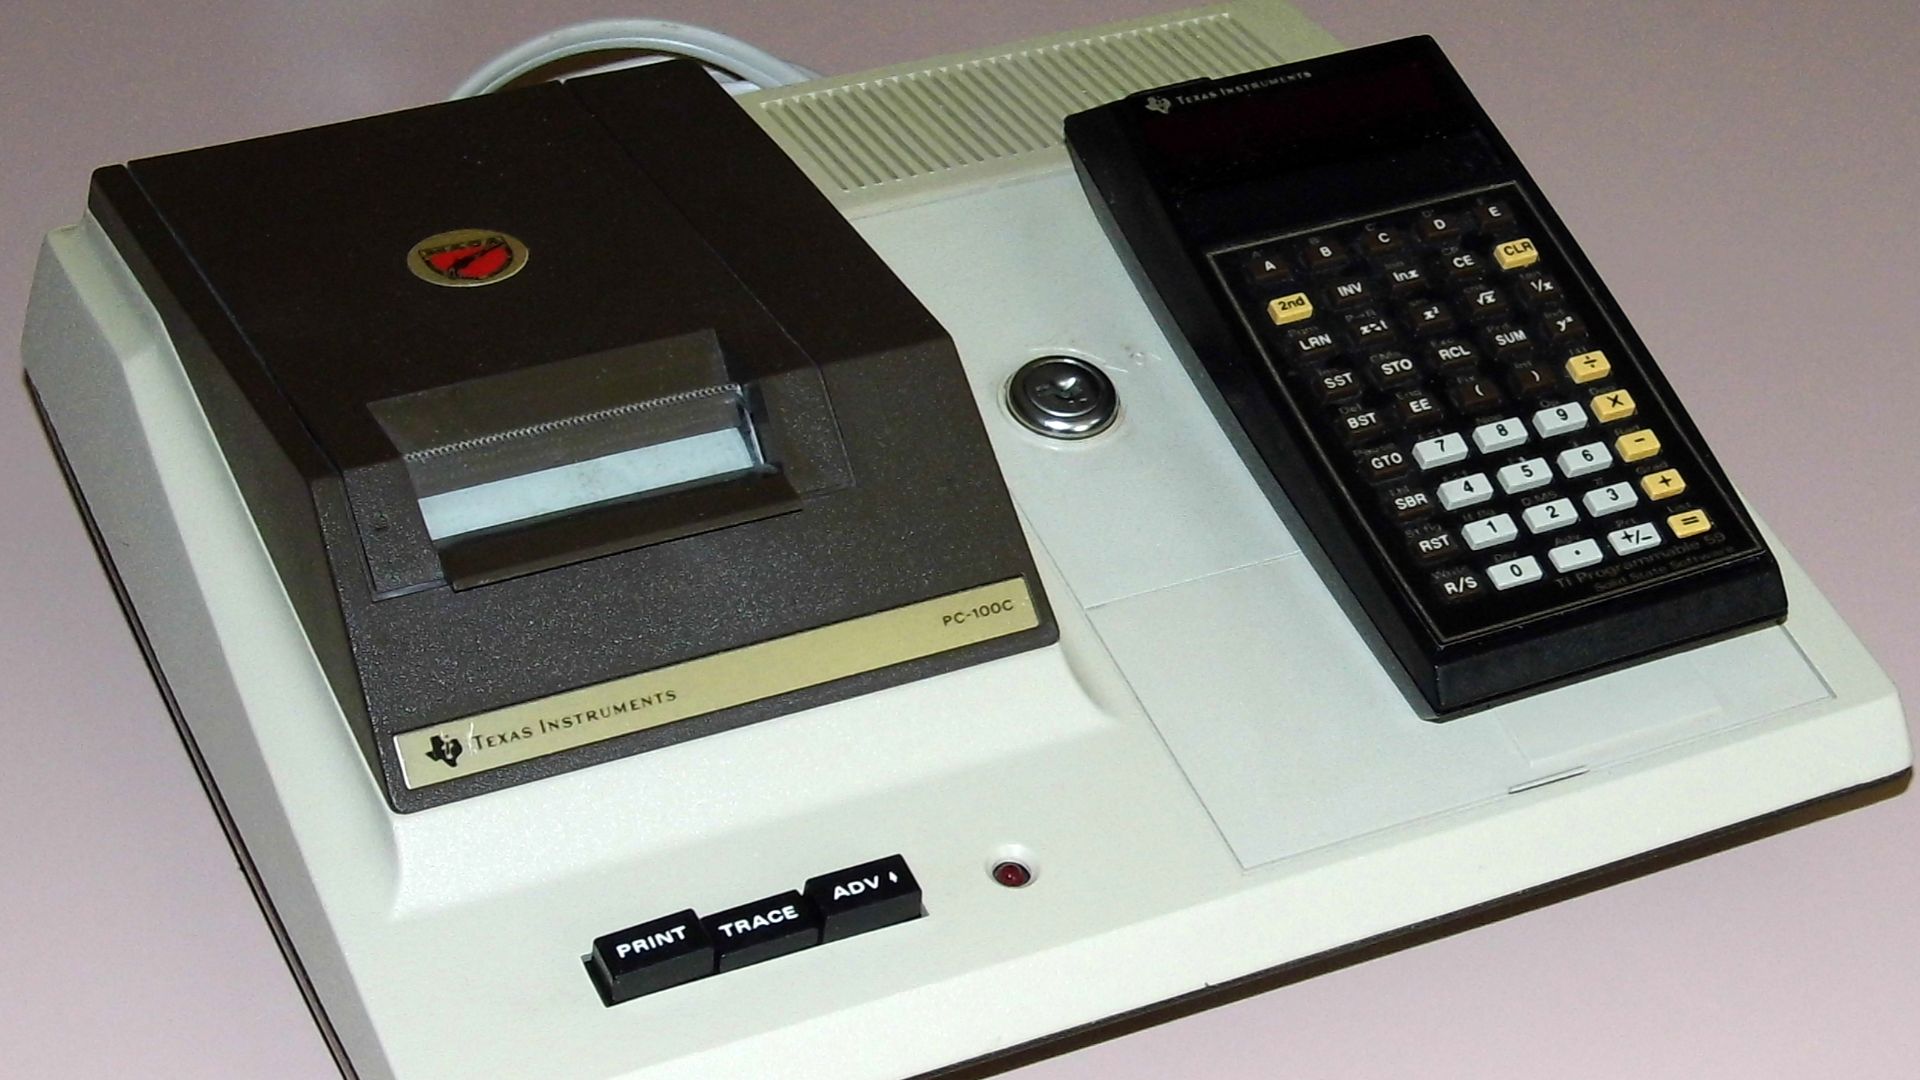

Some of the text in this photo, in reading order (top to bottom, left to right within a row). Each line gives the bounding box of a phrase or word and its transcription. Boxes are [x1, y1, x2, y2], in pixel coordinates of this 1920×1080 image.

[1488, 206, 1502, 218] E
[1432, 218, 1447, 231] D
[1377, 232, 1391, 244] C
[1319, 245, 1333, 258] B
[1503, 241, 1534, 256] CLR
[1264, 259, 1277, 272] A
[1452, 254, 1476, 269] CE
[1336, 280, 1363, 297] INV
[1278, 296, 1305, 311] 2nd
[1298, 333, 1332, 351] LRN
[1494, 329, 1528, 347] SUM
[1438, 344, 1472, 361] RCL
[1381, 358, 1413, 376] STO
[1323, 371, 1354, 389] SST
[1409, 397, 1433, 414] EE
[1346, 412, 1378, 430] BST
[1556, 408, 1569, 422] 9
[1495, 423, 1508, 437] 8
[1434, 438, 1446, 453] 7
[1370, 452, 1403, 470] GTO
[1581, 449, 1595, 462] 6
[1521, 464, 1534, 478] 5
[1463, 480, 1475, 493] 4
[1606, 487, 1619, 502] 3
[1394, 493, 1429, 511] SBR
[1545, 505, 1560, 519] 2
[1486, 520, 1498, 534] 1
[1418, 534, 1451, 553] RST
[1444, 576, 1479, 596] R/S
[942, 599, 1015, 627] PC-100C
[473, 689, 677, 751] TEXAS INSTRUMENTS
[832, 874, 880, 901] ADV
[718, 904, 800, 938] TRACE
[616, 925, 687, 959] PRINT
